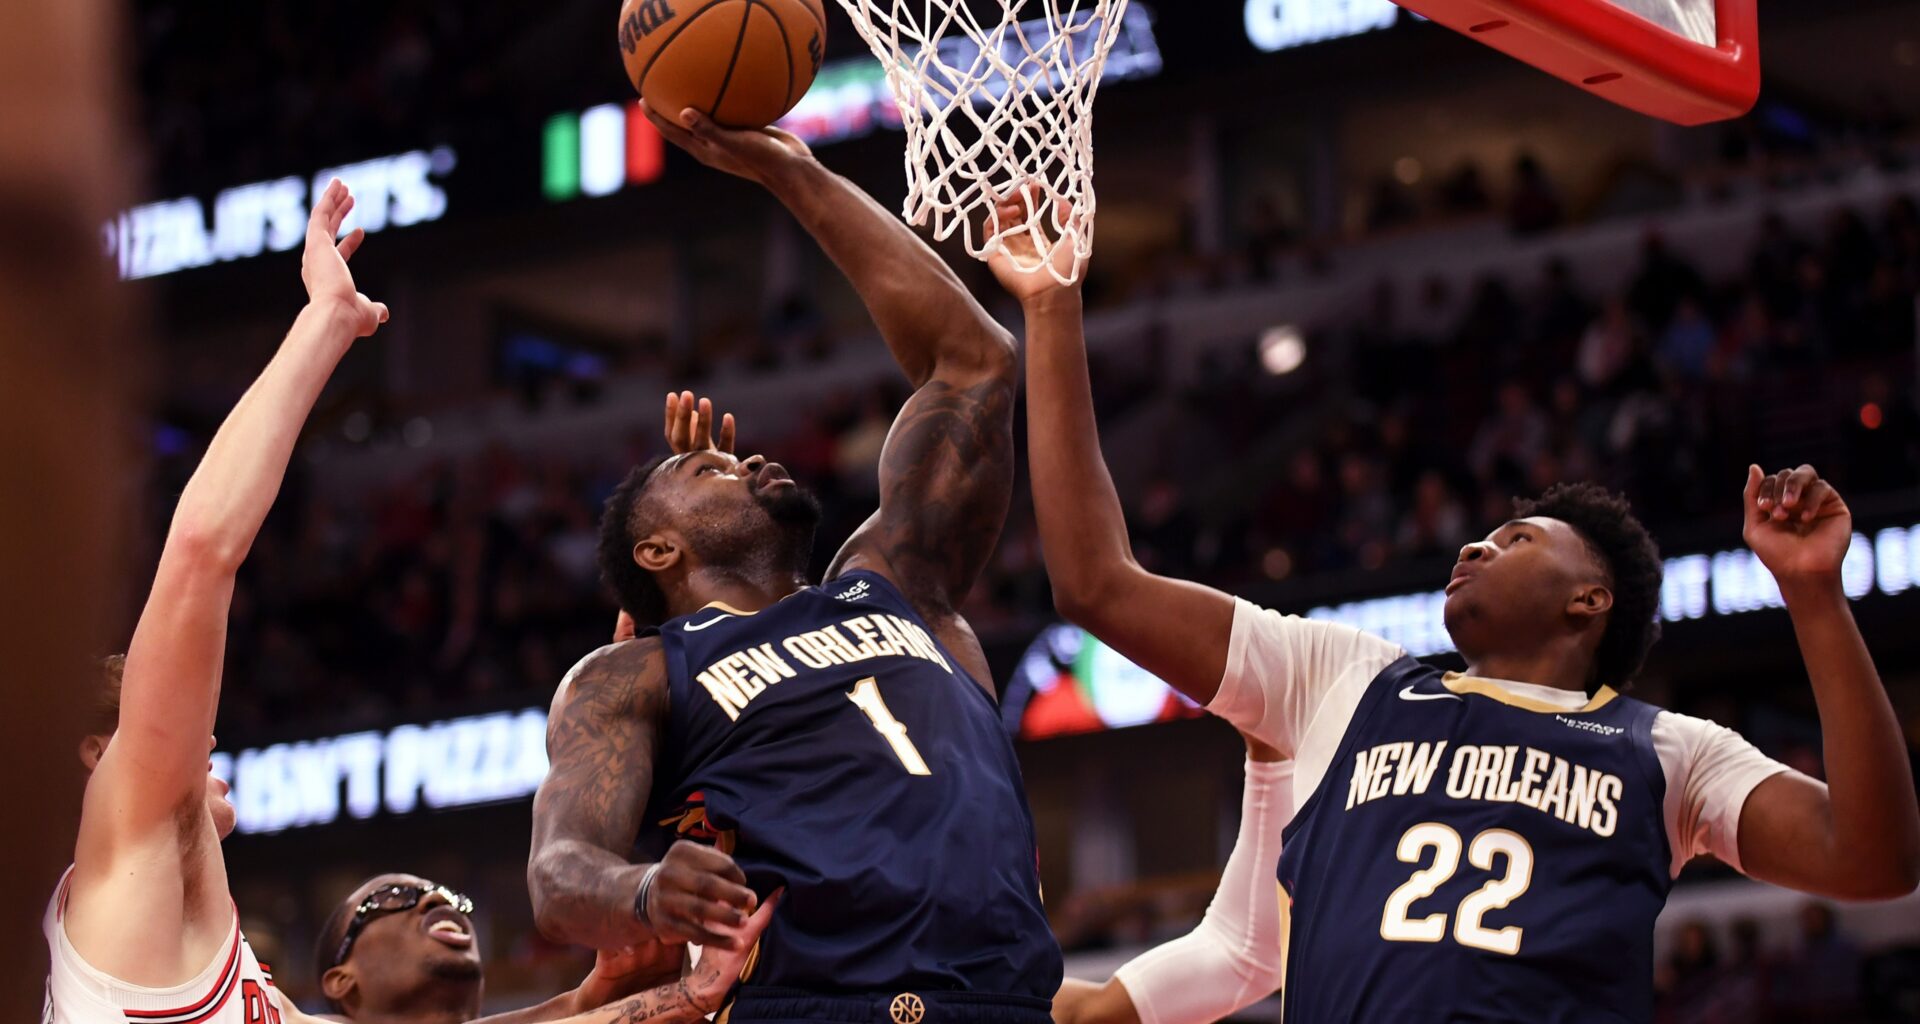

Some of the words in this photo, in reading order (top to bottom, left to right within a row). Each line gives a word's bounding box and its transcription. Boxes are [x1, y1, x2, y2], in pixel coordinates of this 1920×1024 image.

[696, 643, 797, 722] NEW
[782, 614, 953, 674] ORLEANS
[845, 676, 932, 775] 1
[1345, 740, 1448, 811] NEW
[1446, 745, 1624, 837] ORLEANS
[1380, 821, 1534, 956] 22
